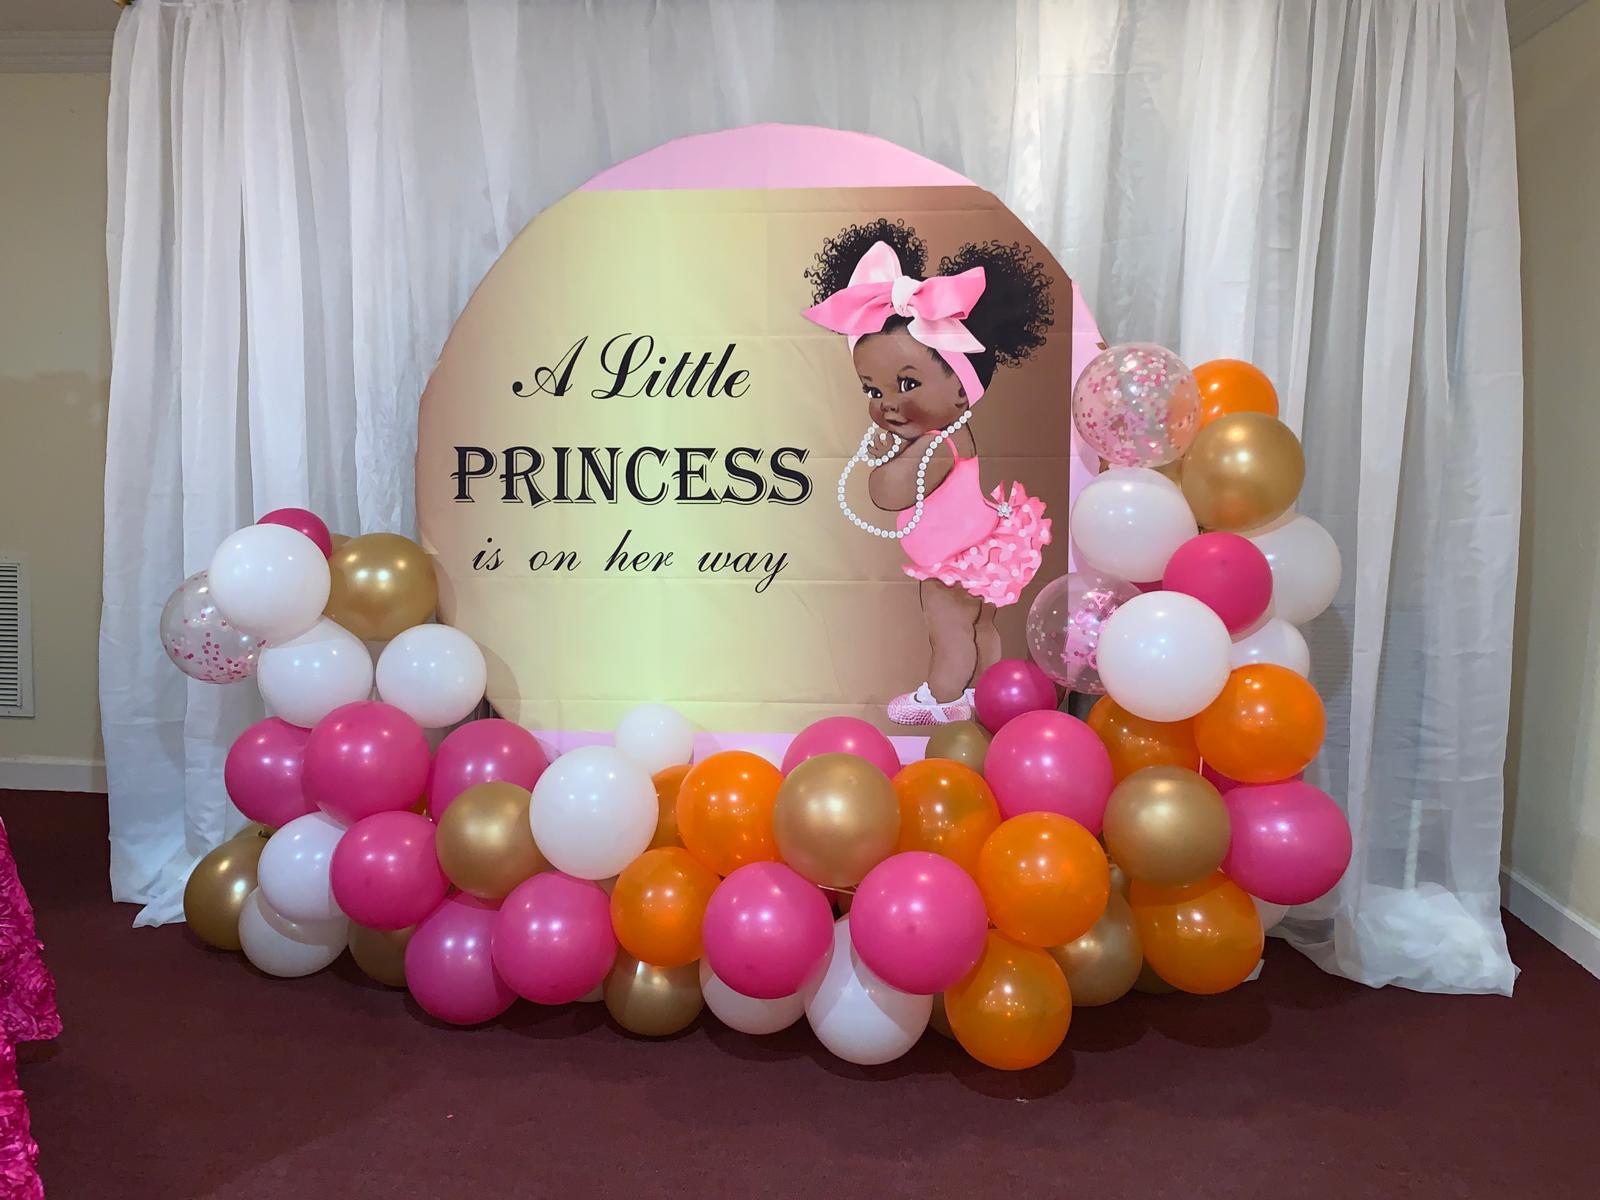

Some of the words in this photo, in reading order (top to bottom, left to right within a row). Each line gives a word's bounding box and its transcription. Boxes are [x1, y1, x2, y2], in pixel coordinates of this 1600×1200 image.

[512, 335, 589, 398] A
[590, 332, 751, 400] Little
[450, 446, 813, 508] PRINCESS
[472, 537, 504, 571] is
[528, 549, 582, 572] on
[603, 529, 674, 573] her
[697, 551, 789, 594] way
